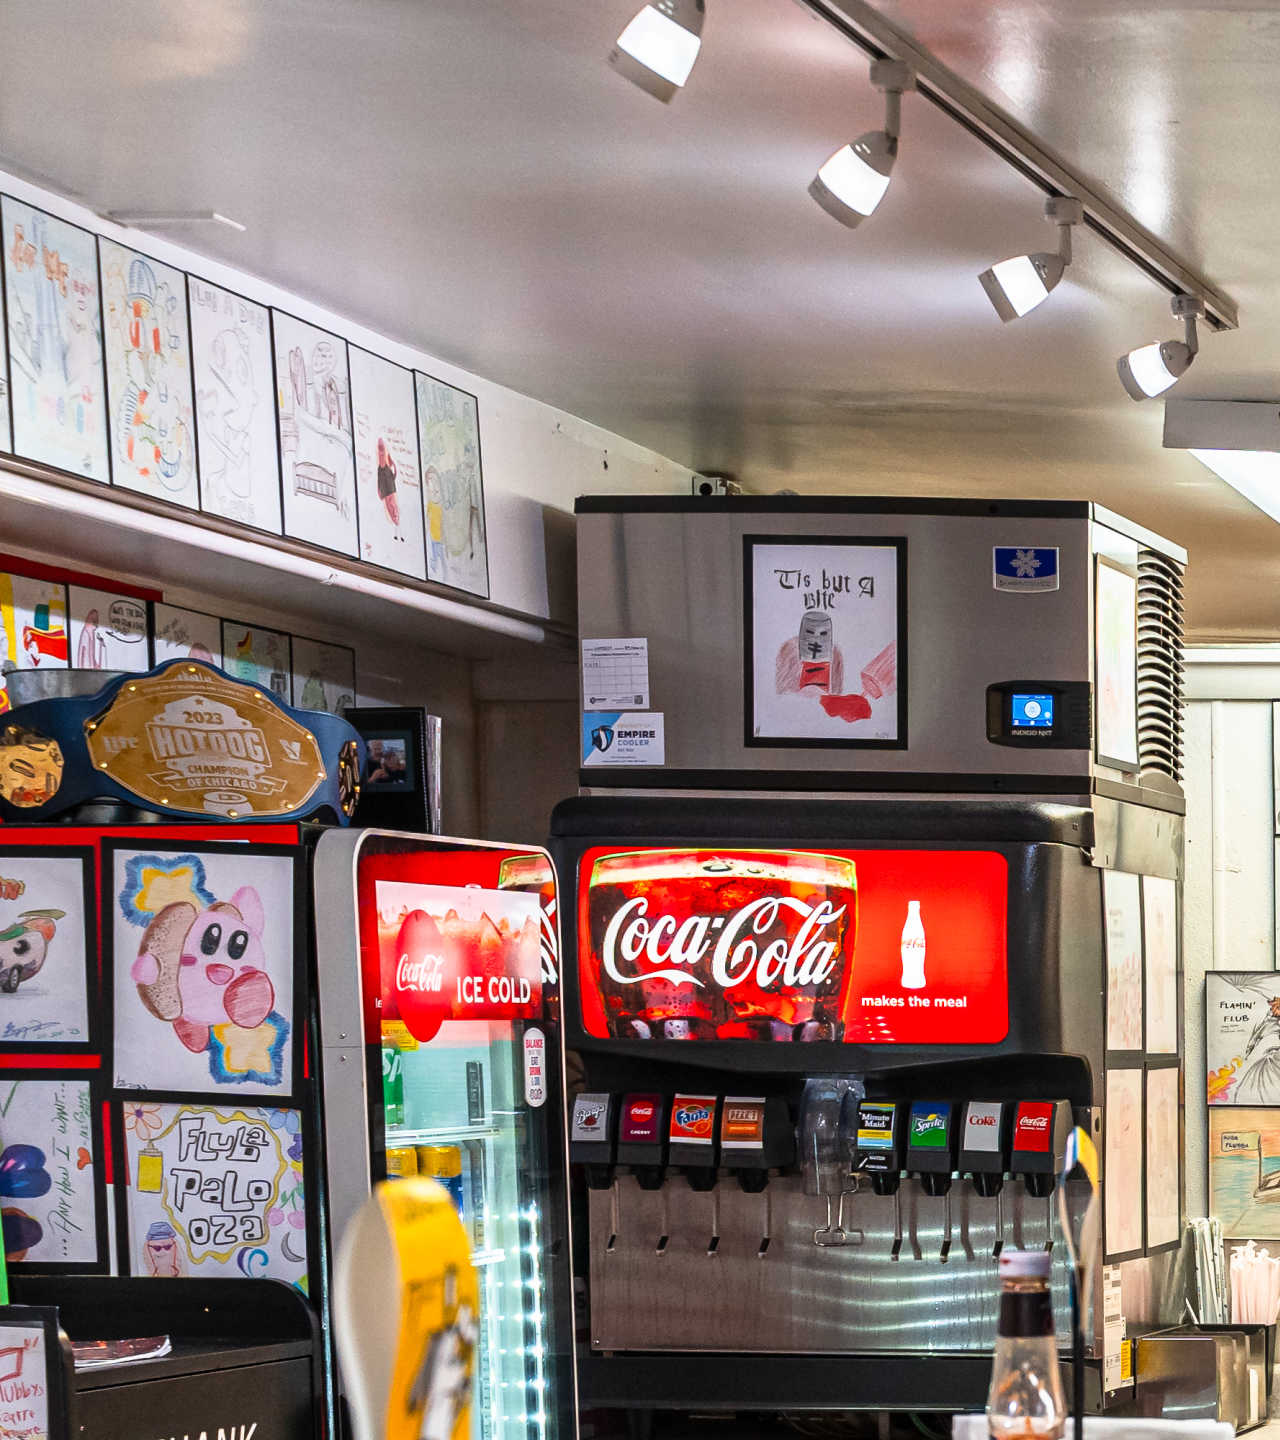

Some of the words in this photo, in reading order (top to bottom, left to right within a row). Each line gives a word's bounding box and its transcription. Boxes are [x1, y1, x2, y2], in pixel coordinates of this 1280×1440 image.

[822, 569, 850, 593] but
[184, 710, 224, 724] 2023
[617, 730, 656, 739] EMPIRE
[158, 725, 262, 761] HOTDOG
[188, 765, 249, 776] CHAMPION
[188, 778, 202, 788] OF
[203, 778, 257, 790] CHICAGO
[603, 897, 846, 987] Coca-Cola
[396, 954, 444, 991] Coca-Cola
[457, 977, 484, 1003] ICE
[488, 977, 531, 1003] COLD
[861, 996, 903, 1007] makes
[908, 996, 930, 1007] the
[934, 996, 967, 1007] meal
[859, 1112, 891, 1121] Minute
[970, 1114, 998, 1127] Coke
